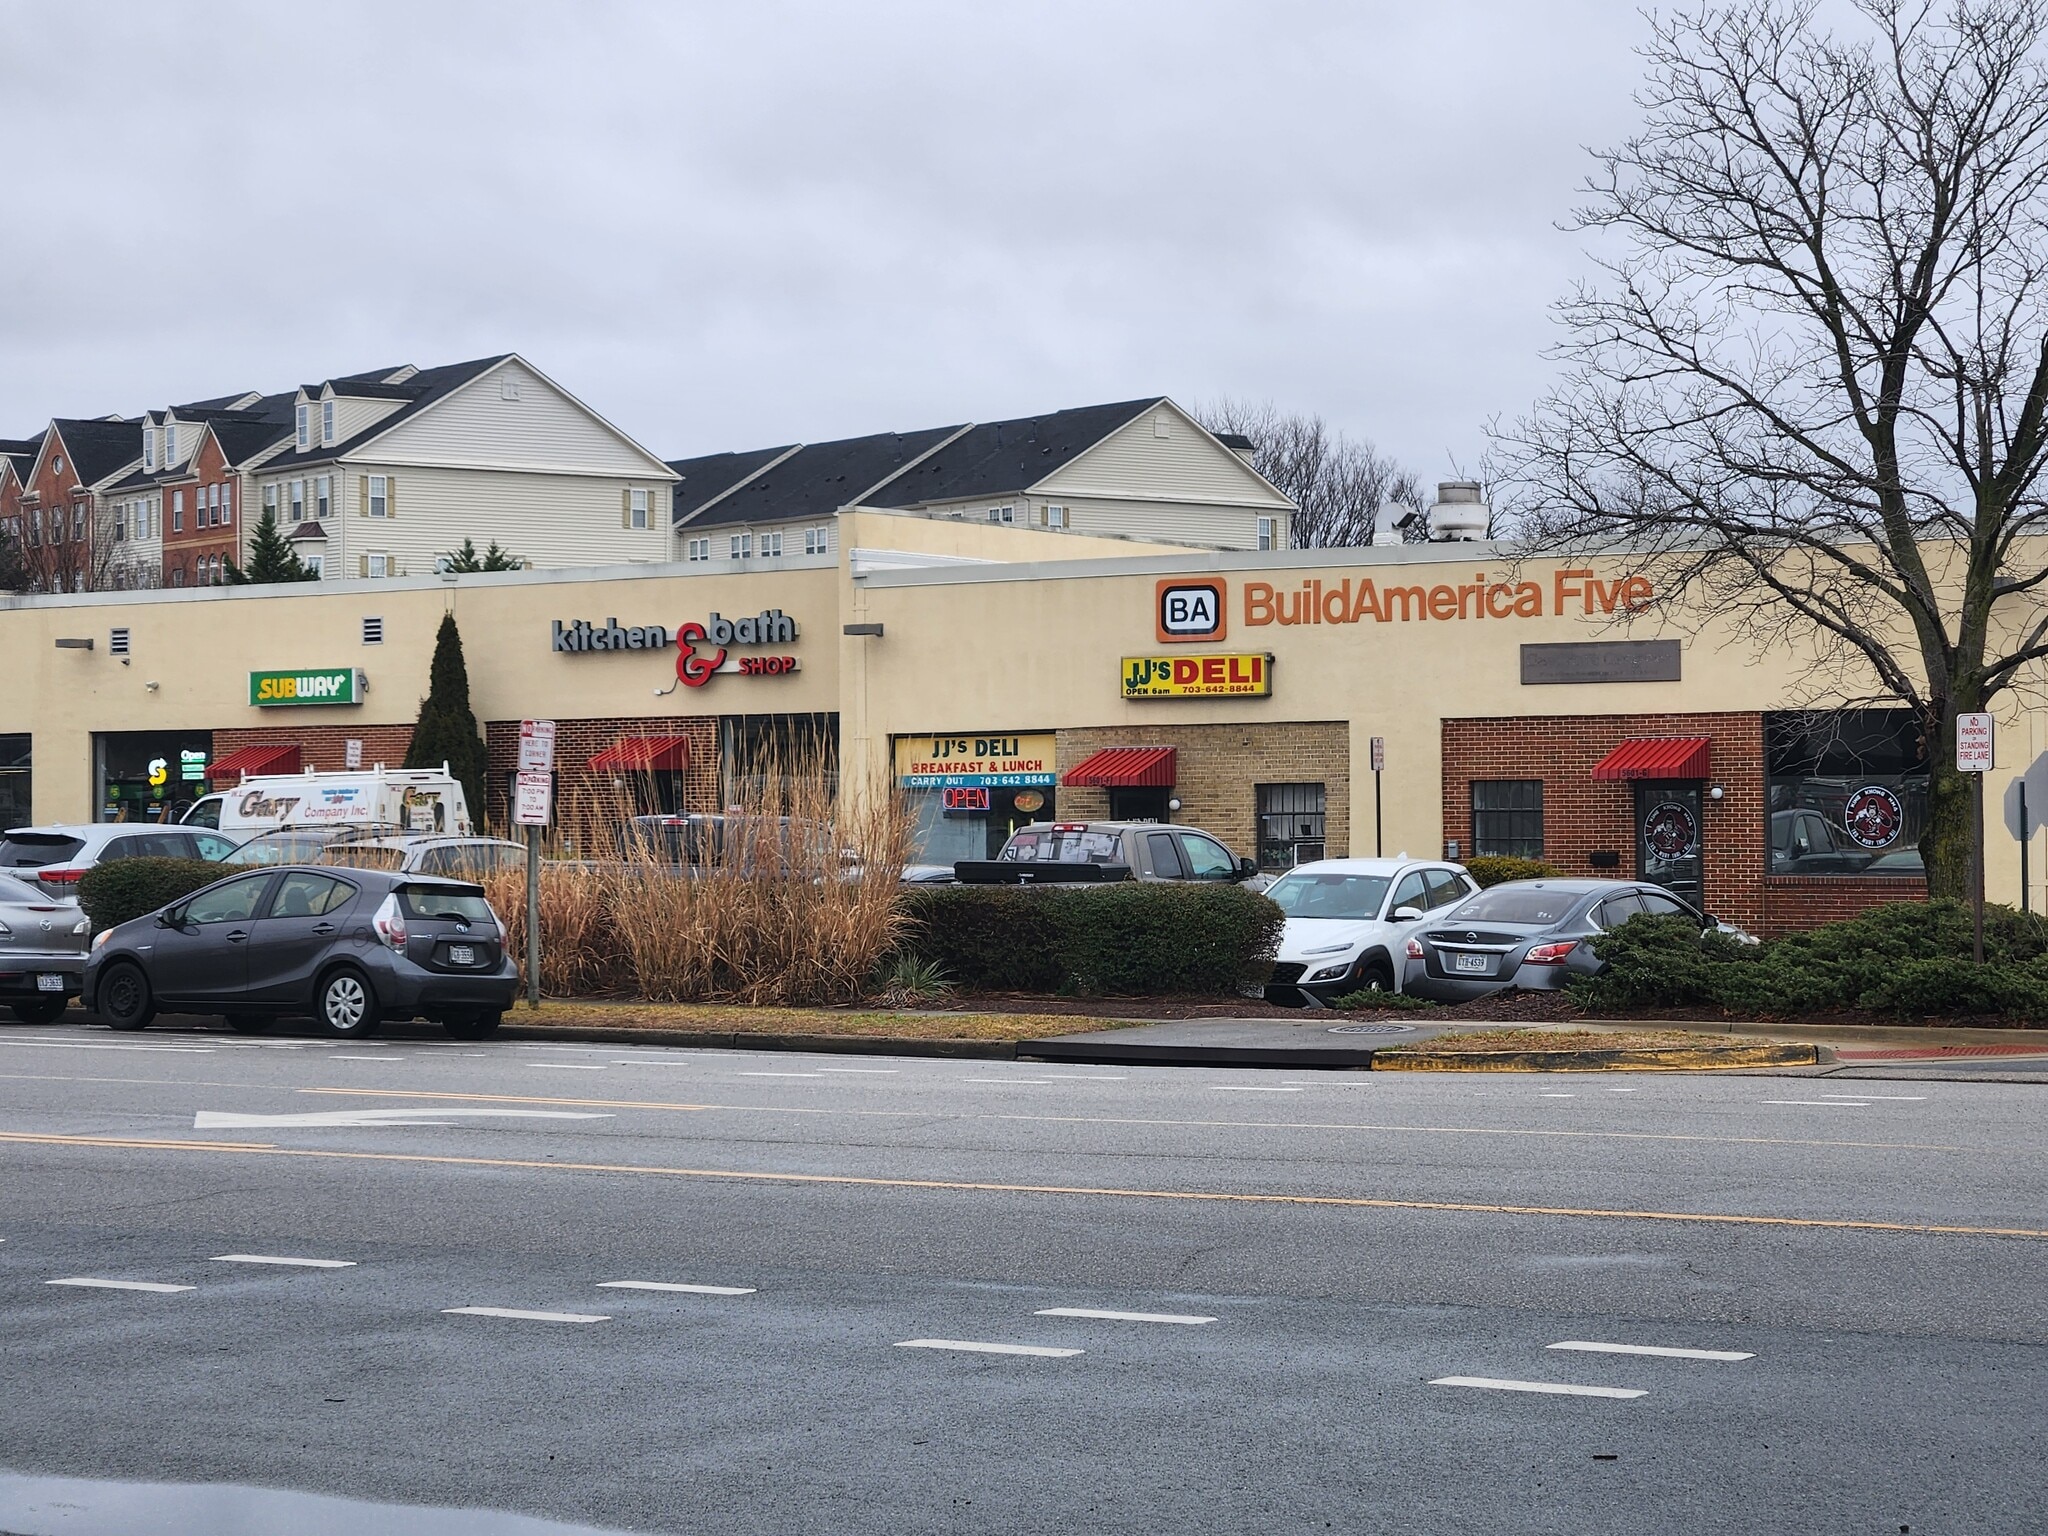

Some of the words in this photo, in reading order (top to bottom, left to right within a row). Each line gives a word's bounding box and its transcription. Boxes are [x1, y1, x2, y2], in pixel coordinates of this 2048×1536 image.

[1244, 573, 1542, 627] BuildAmerica
[1554, 569, 1653, 615] Five
[1170, 597, 1210, 622] BA
[552, 617, 667, 652] kitchen
[676, 622, 727, 688] &
[709, 609, 796, 645] bath
[738, 656, 796, 676] SHOP
[1125, 659, 1171, 688] JJ'S
[1173, 657, 1262, 685] DELI
[257, 673, 346, 700] SUBWAY
[1182, 685, 1255, 693] 703-642-8844
[932, 739, 968, 758] JJ'S
[975, 738, 1019, 757] DELI
[1960, 741, 1989, 749] STANDING
[180, 750, 206, 762] Open
[1960, 751, 1972, 760] FIRE
[1974, 751, 1989, 759] LANE
[911, 762, 983, 774] BREAKFAST
[989, 761, 998, 772] &
[1002, 760, 1042, 772] LUNCH
[911, 776, 941, 786] CARRY
[946, 777, 964, 785] OUT
[980, 776, 998, 785] 703
[1001, 776, 1020, 784] 642
[1024, 774, 1050, 784] 8844
[240, 790, 301, 822] Gary
[304, 806, 348, 819] Company
[351, 805, 368, 816] Inc.
[944, 787, 988, 809] OPEN
